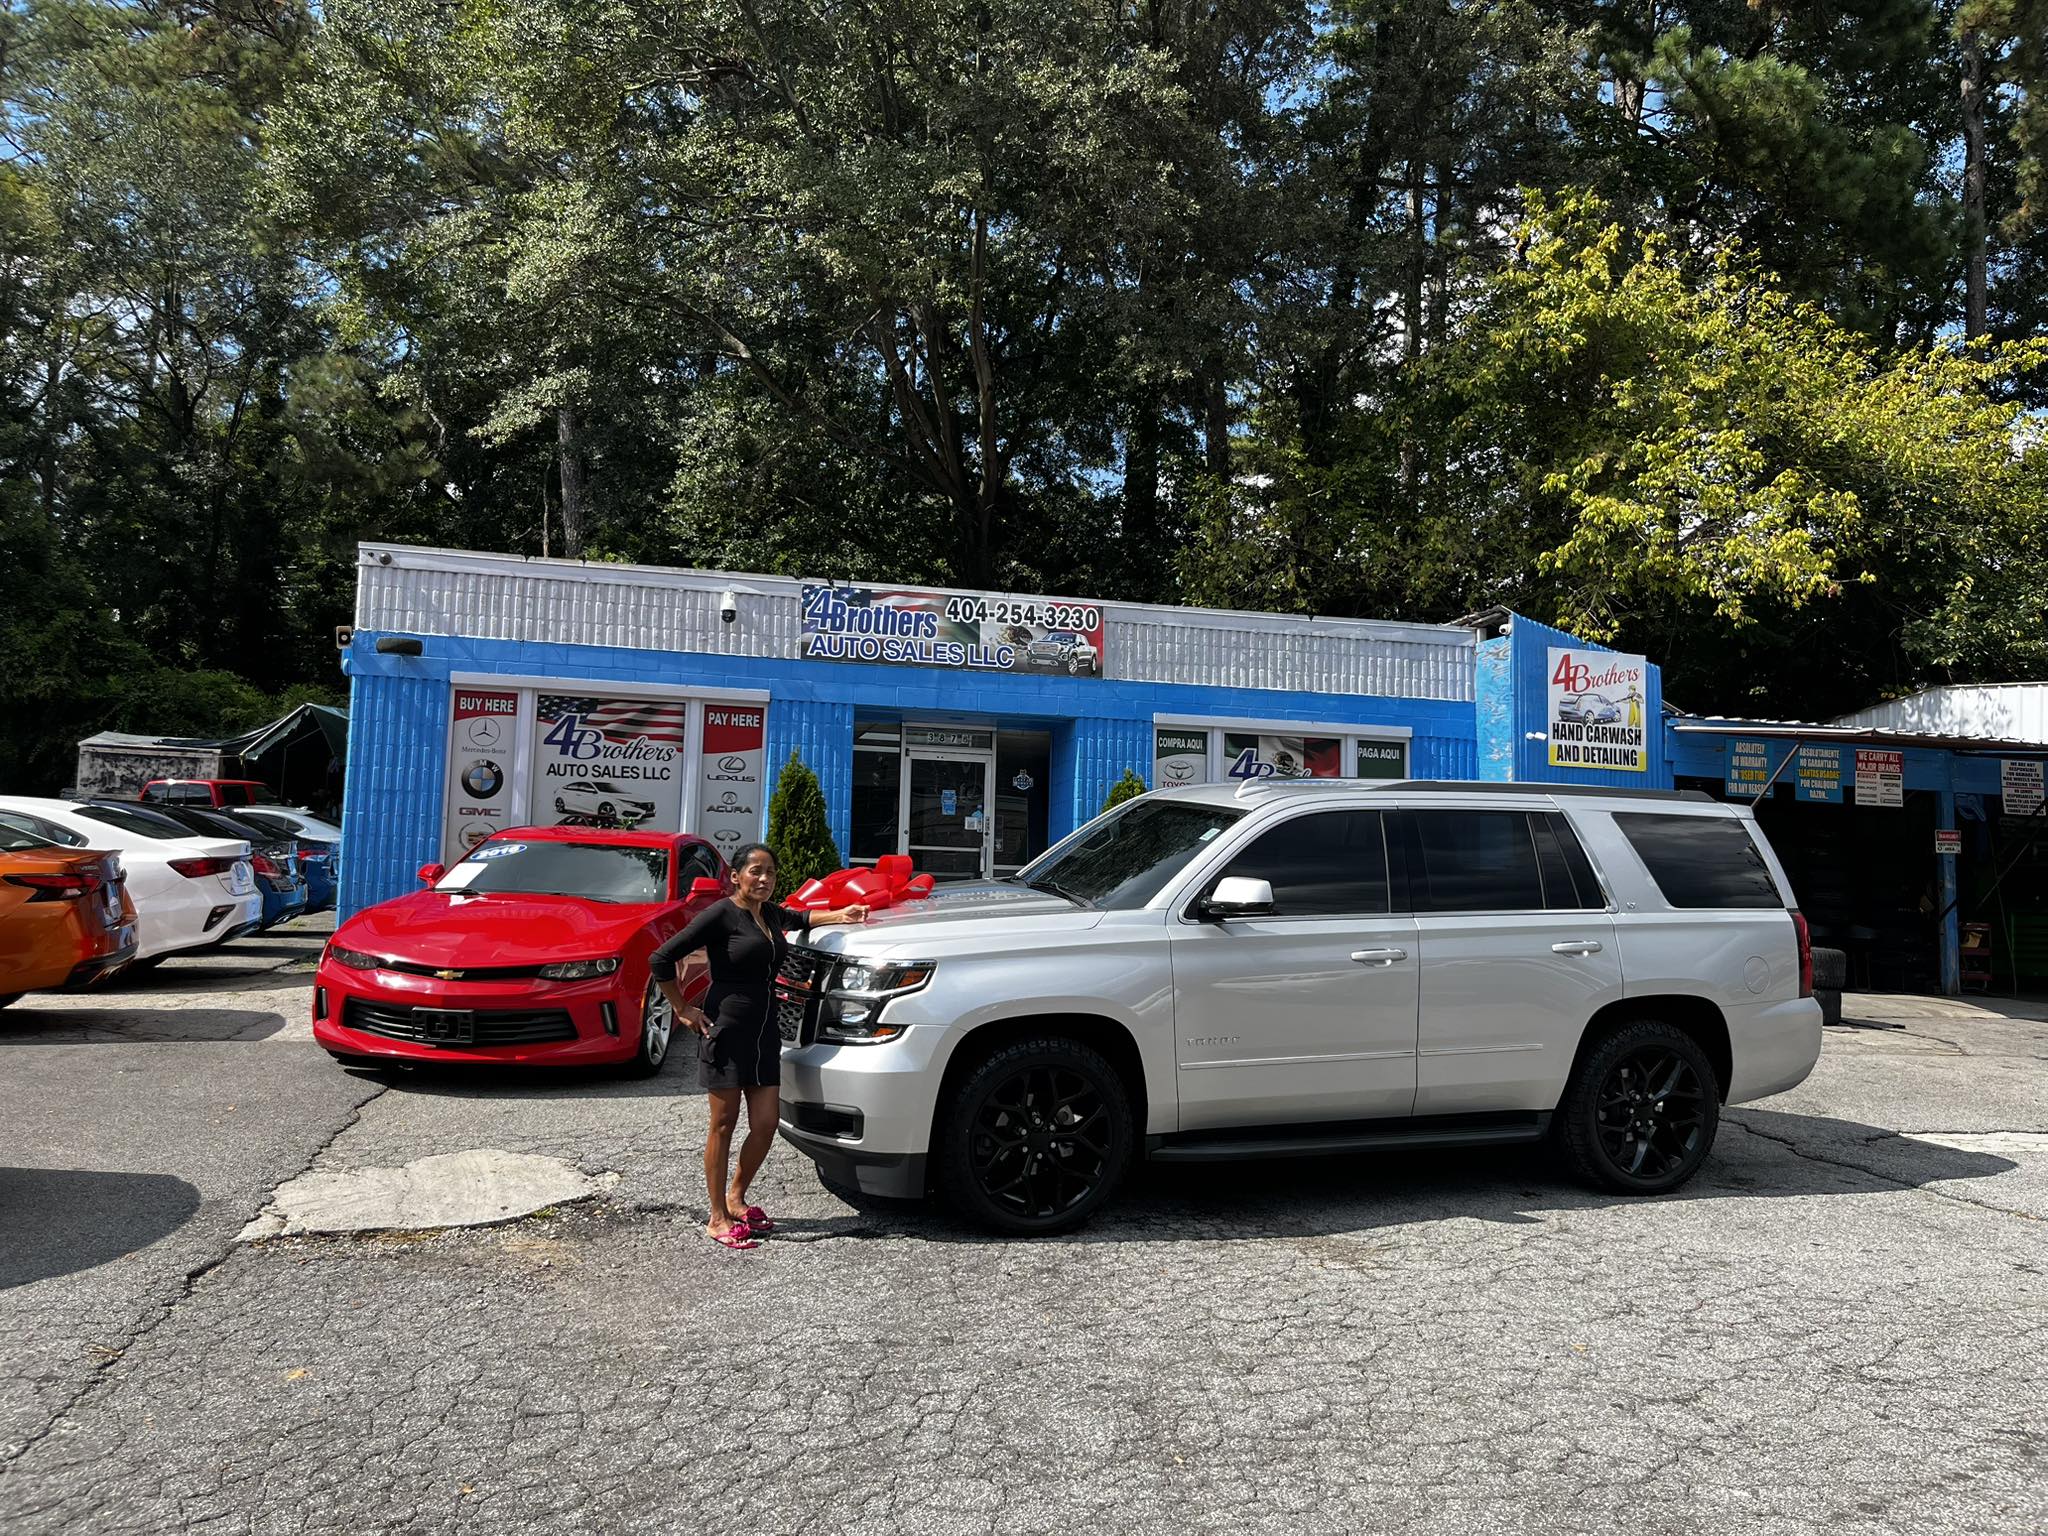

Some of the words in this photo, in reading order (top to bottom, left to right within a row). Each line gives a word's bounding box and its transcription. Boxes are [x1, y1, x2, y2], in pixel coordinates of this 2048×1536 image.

[945, 597, 1099, 631] 404-254-3230
[807, 633, 880, 660] AUTO
[883, 638, 965, 665] SALES
[968, 644, 1014, 669] LLC
[459, 697, 481, 710] BUY
[484, 699, 514, 713] HERE
[708, 712, 729, 726] PAY
[731, 714, 760, 728] HERE
[1552, 722, 1584, 742] HAND
[1586, 725, 1642, 746] CARWASH
[1158, 737, 1185, 749] COMPRA
[1186, 739, 1203, 750] AQUI
[1735, 742, 1765, 754] ABSOLUTELY
[461, 746, 507, 755] Mercedes-Benz
[1358, 747, 1379, 759] PAGA
[1380, 748, 1400, 760] AQUI
[1556, 744, 1580, 762] AND
[1583, 746, 1638, 767] DETAILING
[1800, 758, 1808, 767] NO
[1858, 752, 1867, 760] WE
[1869, 752, 1888, 761] CARRY
[1889, 753, 1899, 762] ALL
[546, 763, 589, 778] AUTO
[591, 764, 640, 779] SALES
[643, 766, 671, 780] LLC
[1856, 762, 1877, 771] MAJOR
[1877, 763, 1900, 772] BRANDS
[707, 774, 756, 783] LEXUS
[1800, 780, 1810, 788] POR
[459, 807, 502, 817] GMC
[706, 805, 753, 814] ACURA
